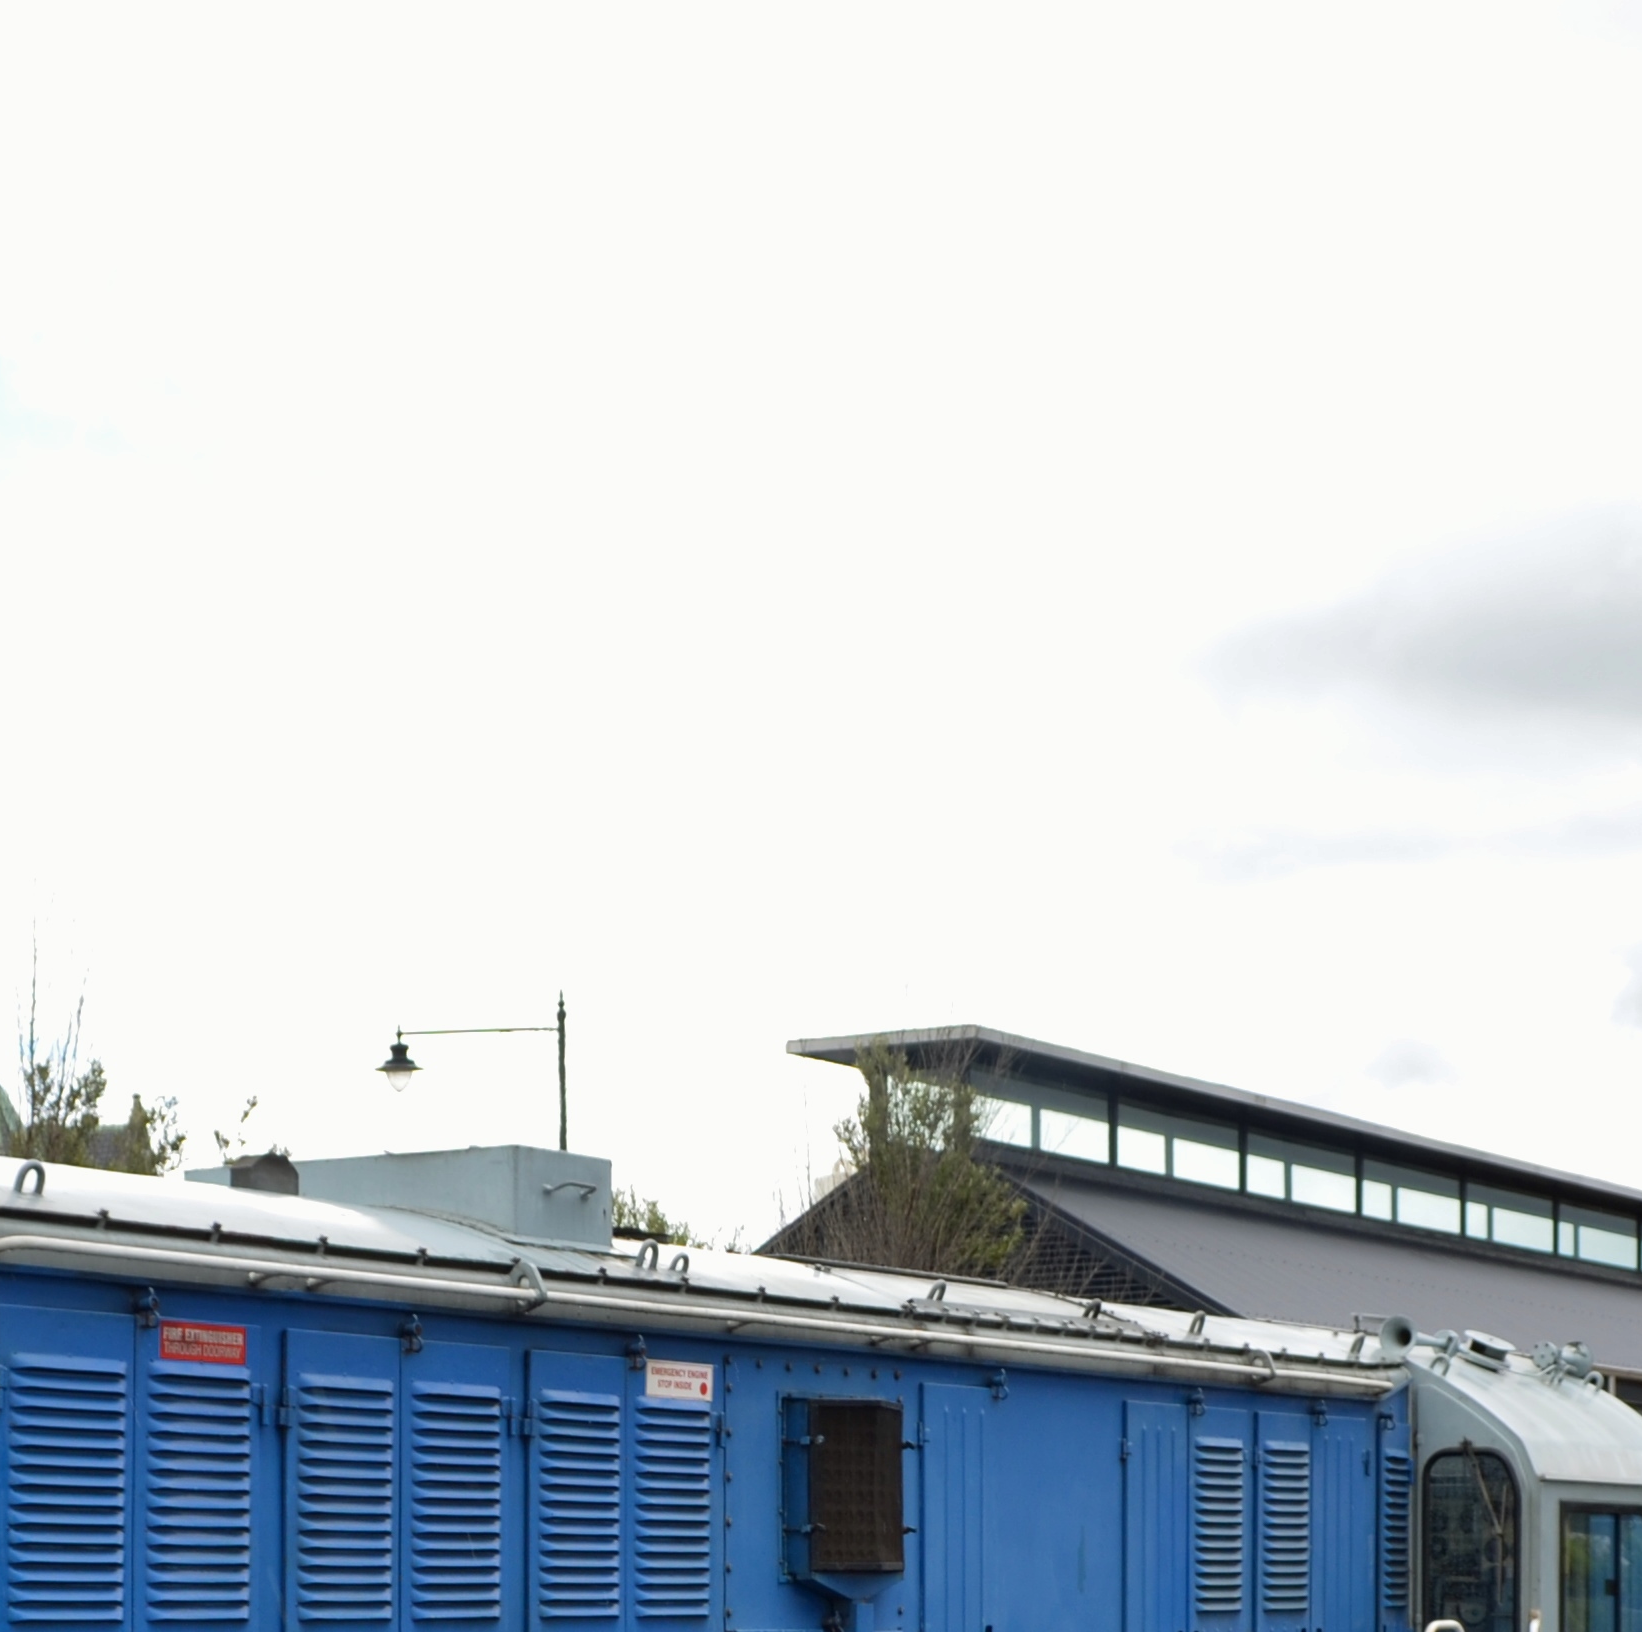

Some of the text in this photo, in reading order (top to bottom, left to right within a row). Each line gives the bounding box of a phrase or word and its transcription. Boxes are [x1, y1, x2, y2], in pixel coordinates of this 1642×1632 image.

[163, 1326, 243, 1345] FIRE EXTINGUISHER
[164, 1341, 241, 1358] THROUGH DOORWAY
[651, 1366, 708, 1379] EMERGENCY ENGINE
[658, 1379, 692, 1390] STOP INSIDE
